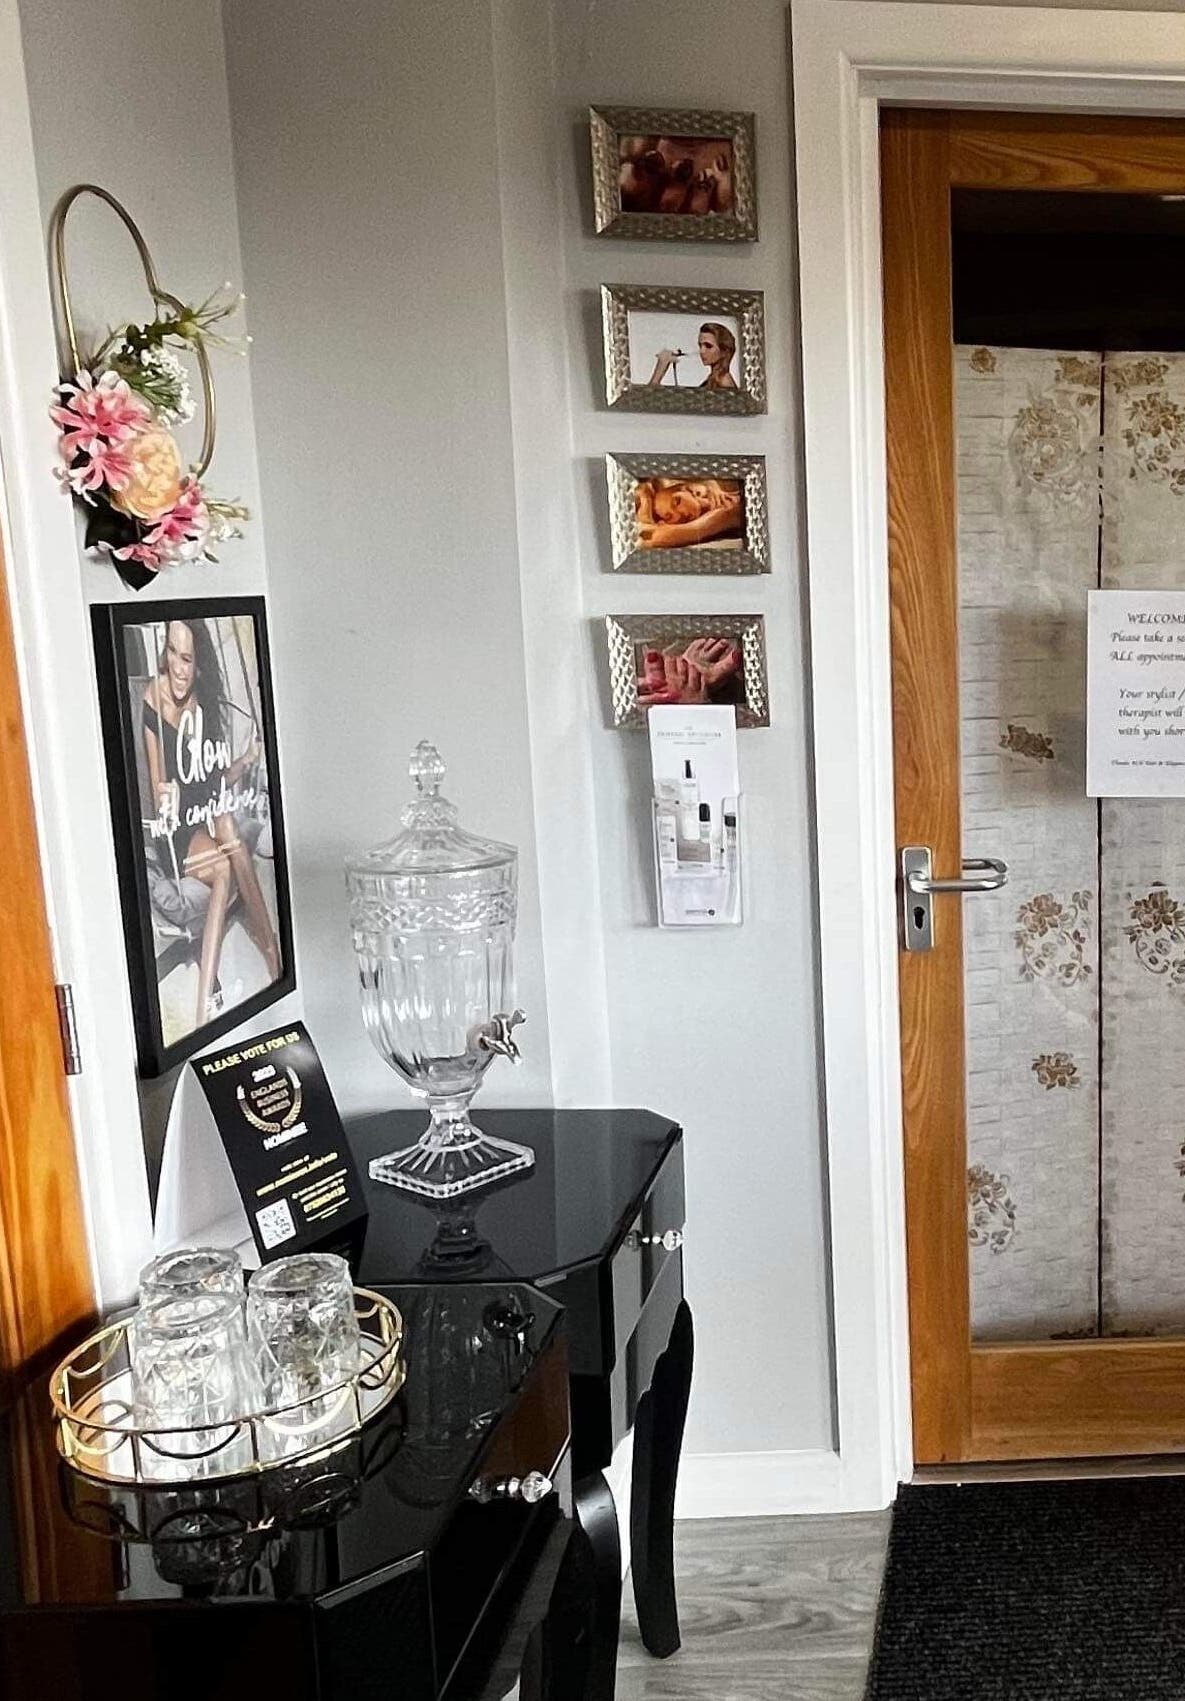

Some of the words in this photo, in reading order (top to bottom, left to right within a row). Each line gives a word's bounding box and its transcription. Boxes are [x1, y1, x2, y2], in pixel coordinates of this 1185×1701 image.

[1111, 630, 1140, 642] Please
[1143, 630, 1164, 643] take
[1166, 634, 1174, 643] a
[1110, 650, 1133, 662] ALL
[1119, 688, 1144, 699] Your
[1146, 686, 1176, 704] stylist
[1118, 705, 1162, 722] therapist
[1164, 705, 1184, 718] will
[1118, 724, 1141, 736] with
[1143, 728, 1161, 741] you
[176, 704, 231, 785] Glow
[202, 1052, 243, 1076] PLEASE
[240, 1044, 268, 1061] VOTE
[267, 1037, 288, 1053] FOR
